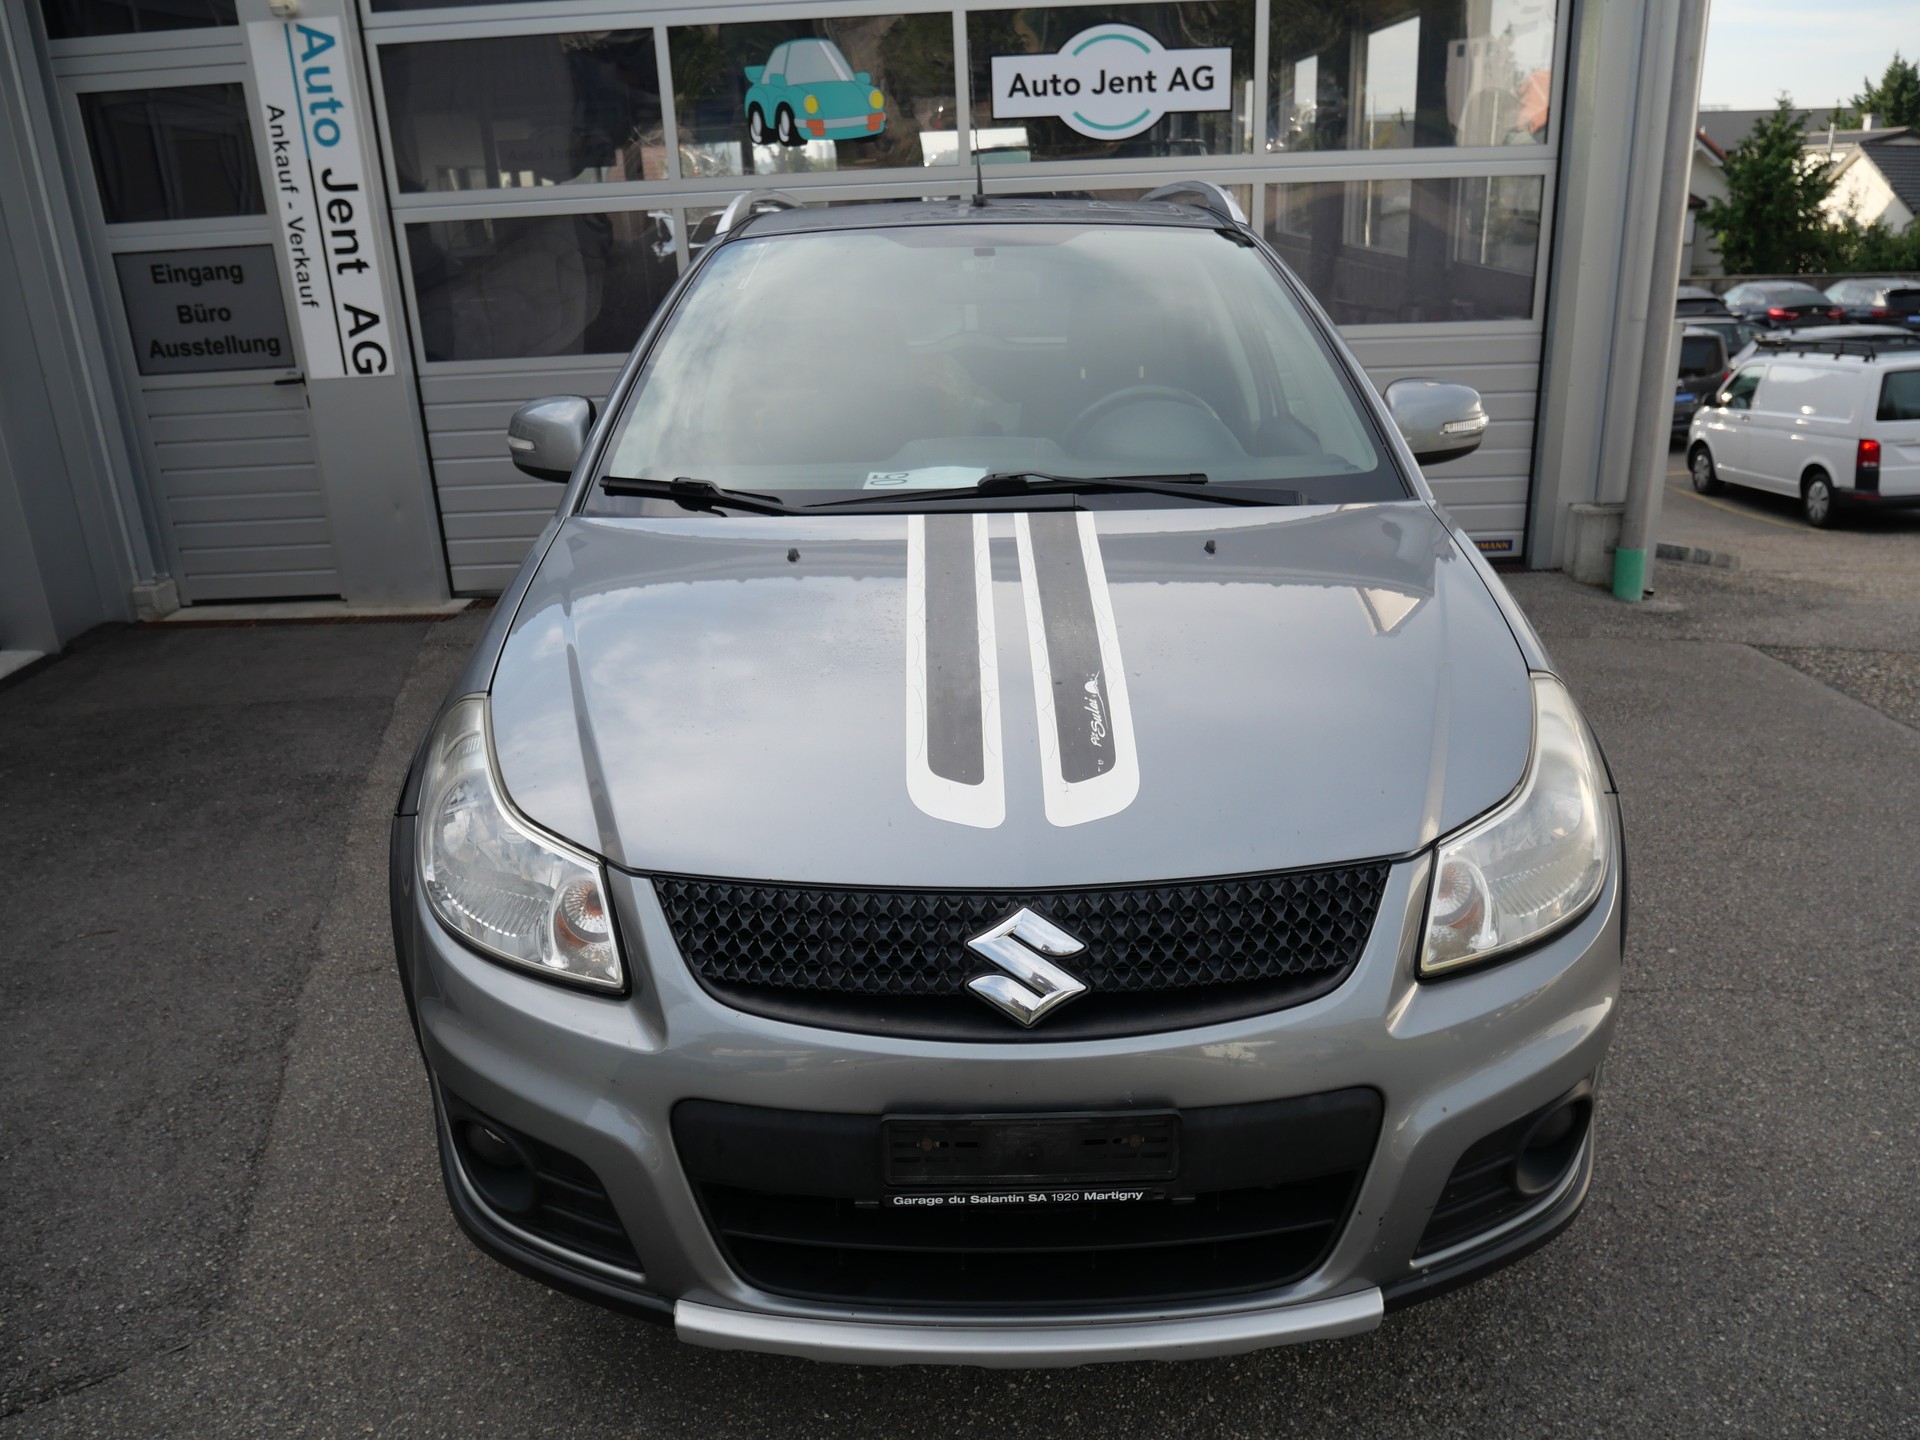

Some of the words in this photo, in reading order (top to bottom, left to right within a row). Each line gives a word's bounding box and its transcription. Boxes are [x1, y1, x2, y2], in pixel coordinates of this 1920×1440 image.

[294, 23, 344, 148] Auto
[1008, 73, 1081, 98] Auto
[1091, 70, 1157, 95] Jent
[1168, 66, 1215, 92] AG
[266, 104, 299, 193] Ankauf
[287, 217, 320, 308] Verkauf
[321, 168, 371, 275] Jent
[150, 264, 244, 287] Eingang
[176, 303, 232, 324] Büro
[149, 334, 281, 359] Ausstellung
[343, 303, 387, 375] AG
[893, 1196, 944, 1206] Garage
[949, 1195, 966, 1204] du
[970, 1194, 1025, 1204] Salantin
[1028, 1194, 1048, 1203] SA
[1051, 1192, 1080, 1202] 1920
[1084, 1190, 1144, 1202] Martigny
